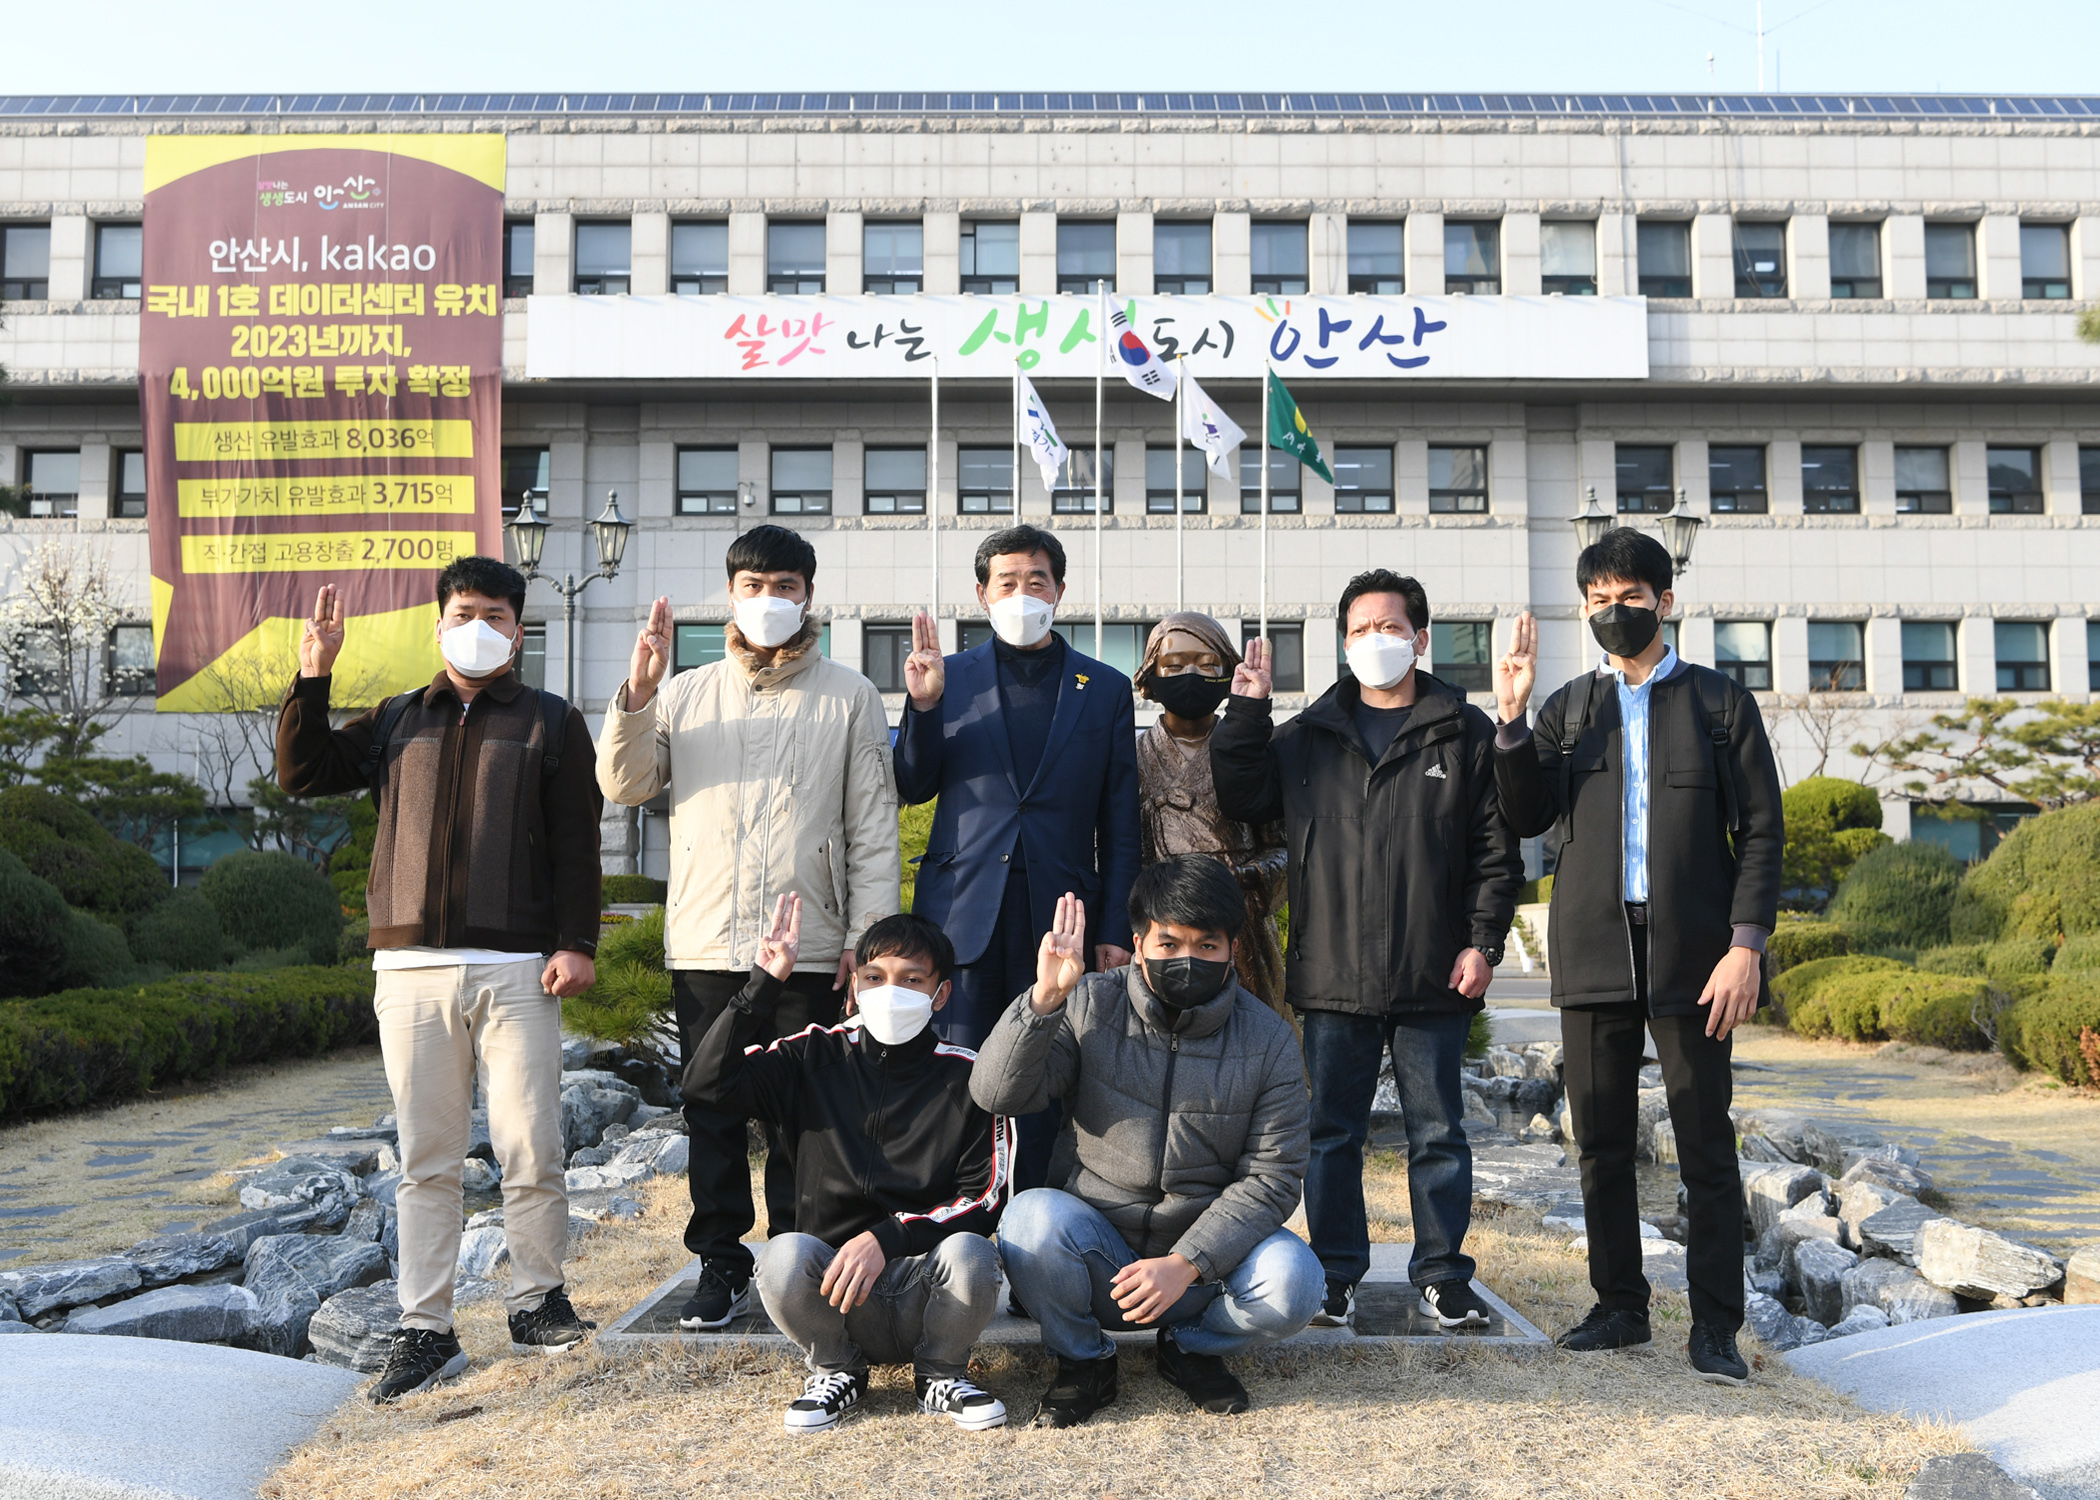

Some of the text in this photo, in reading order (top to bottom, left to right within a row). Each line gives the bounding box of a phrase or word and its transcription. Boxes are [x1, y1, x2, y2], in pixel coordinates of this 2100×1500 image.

[260, 191, 308, 207] 생생도시
[209, 234, 437, 273] 안산시, kakao
[148, 283, 497, 318] 국내 1호 데이터센터 유치
[231, 324, 412, 358] 2023년까지,
[846, 318, 932, 363] 나는
[1270, 306, 1448, 370] 안산
[170, 364, 471, 401] 4,000억원 투자 확정
[214, 427, 435, 453] 생산 유발효과 8,036억
[202, 481, 453, 509] 부가가치 유발효과 3,715억
[275, 539, 354, 563] 고용창출
[361, 537, 454, 564] 2,700명
